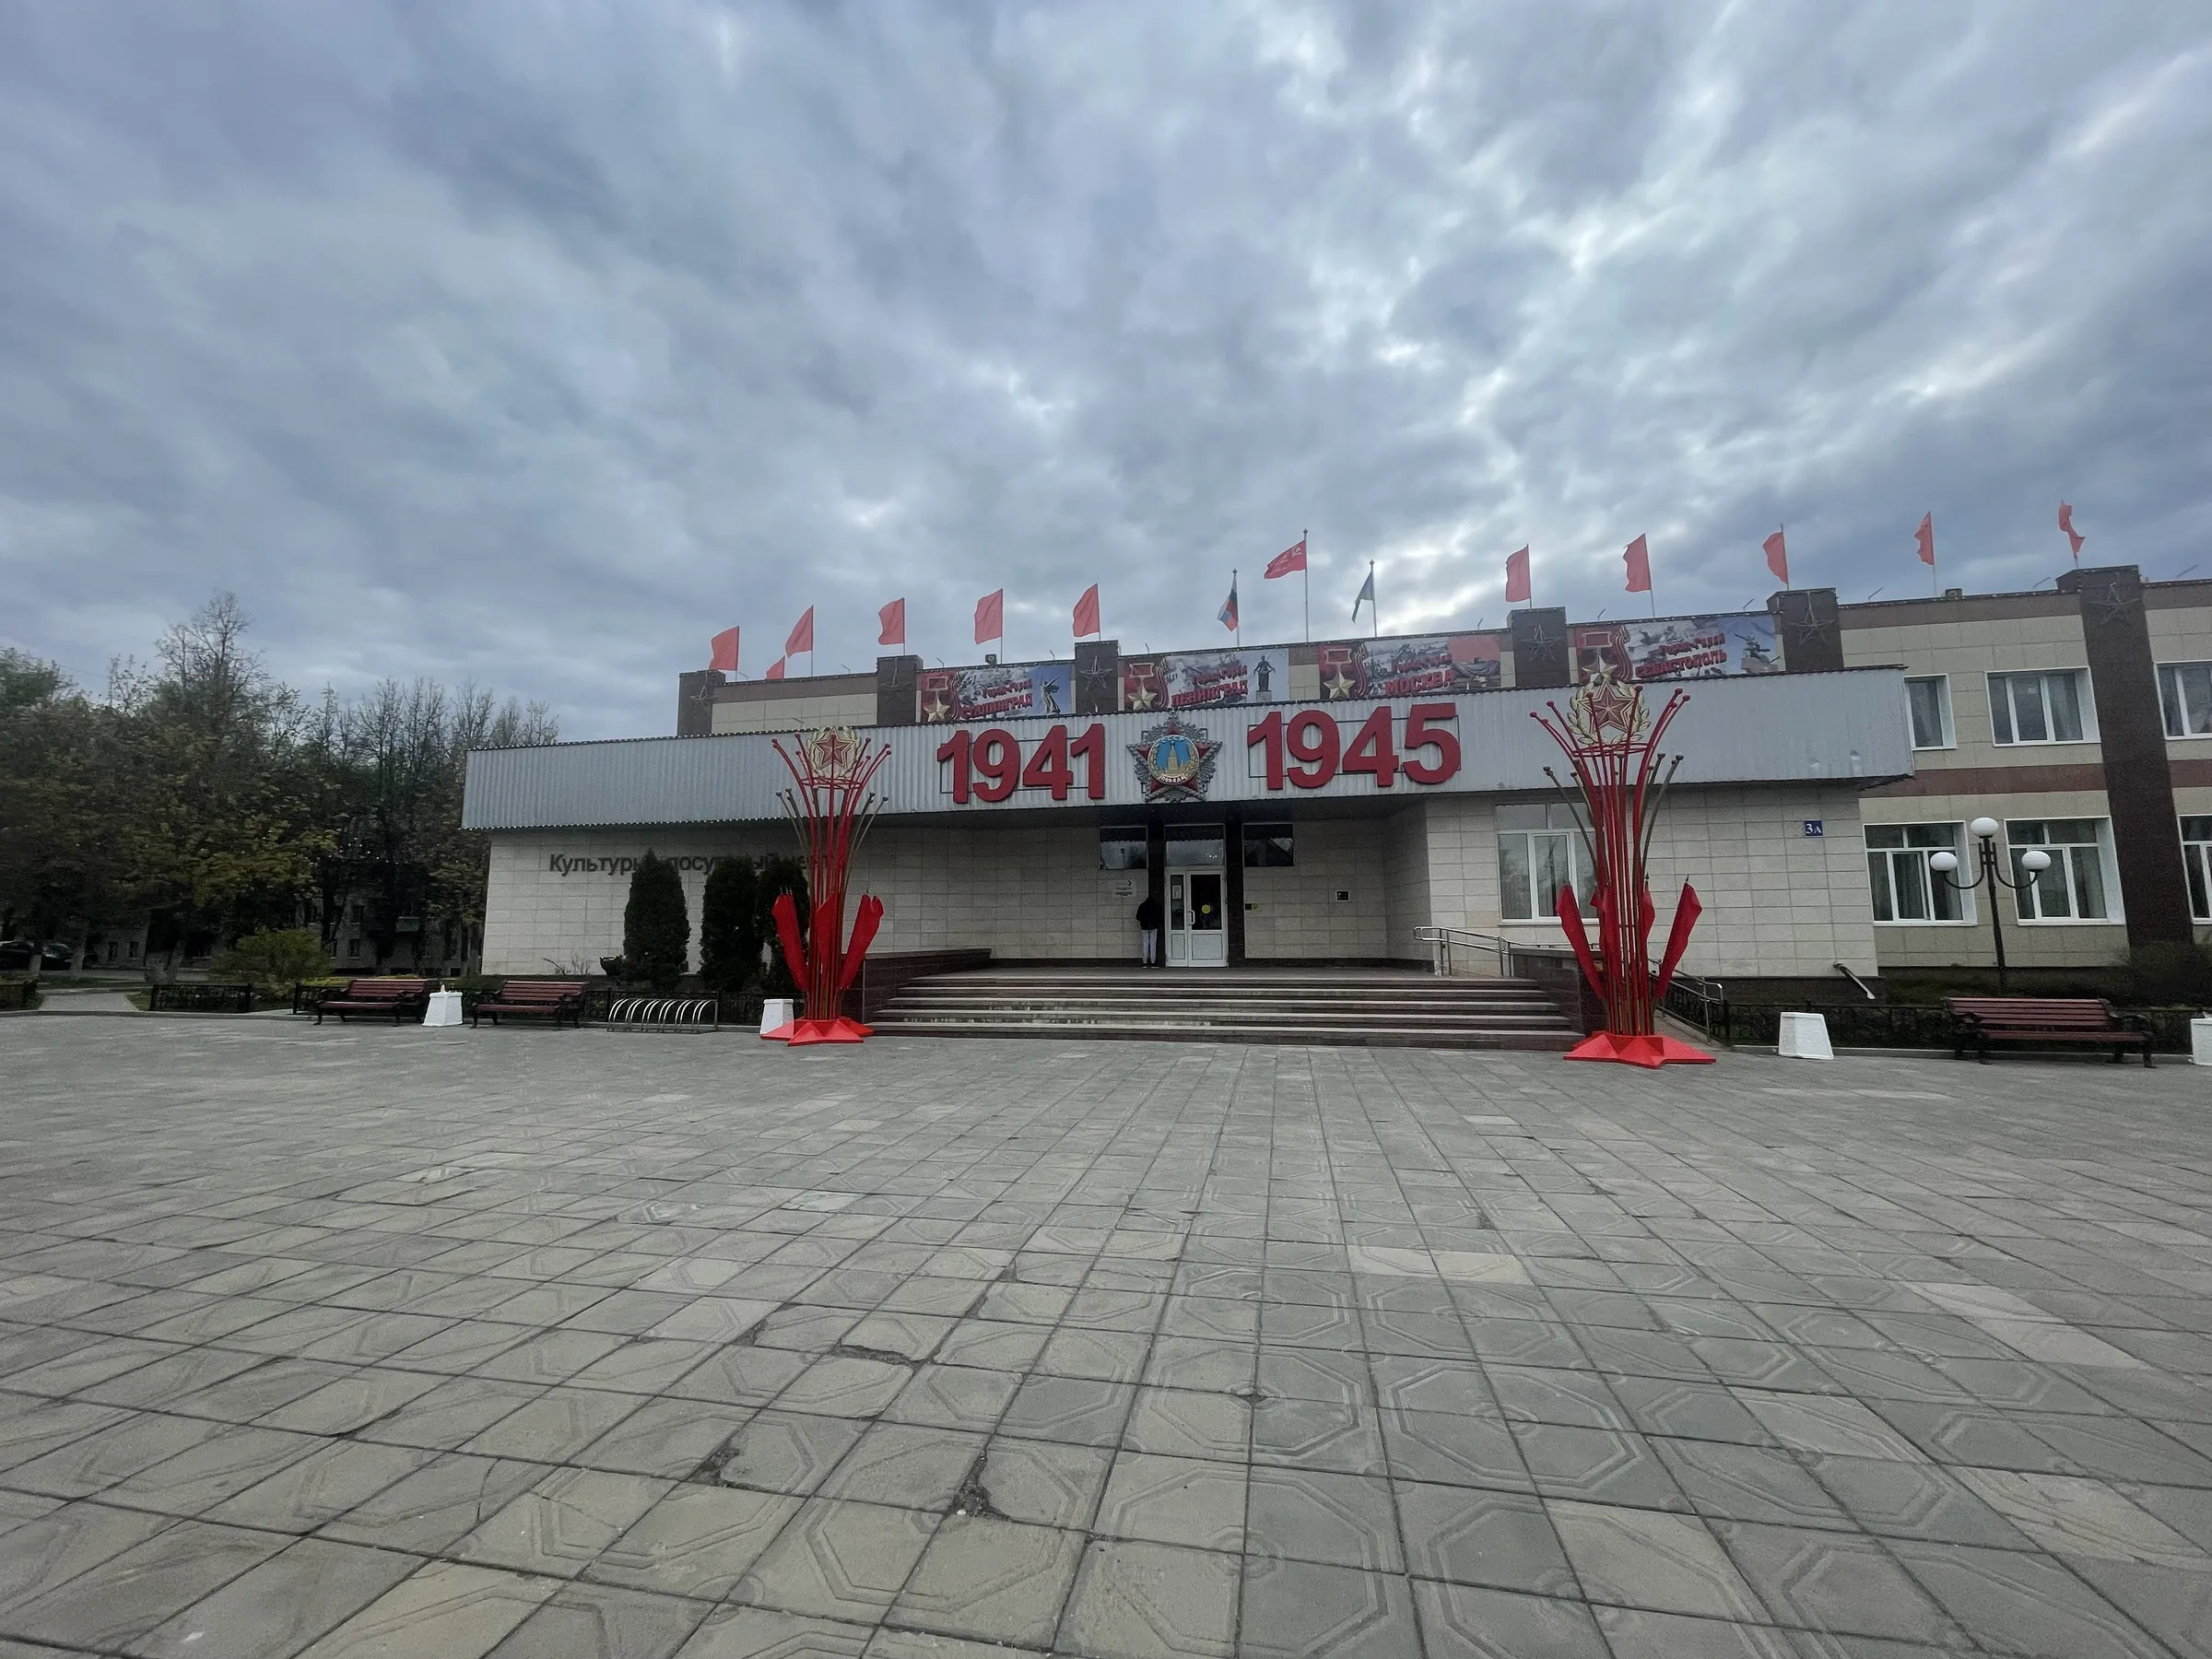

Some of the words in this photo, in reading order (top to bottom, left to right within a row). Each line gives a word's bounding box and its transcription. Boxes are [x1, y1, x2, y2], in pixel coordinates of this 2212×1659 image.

[1171, 679, 1249, 707] ЛЕНИНГРАД
[1385, 669, 1455, 697] МОСКВА
[960, 693, 1033, 719] СТАЛИНГРАД
[936, 723, 1105, 805] 1941
[1247, 702, 1462, 790] 1945
[1160, 775, 1186, 783] ПОБЕДА
